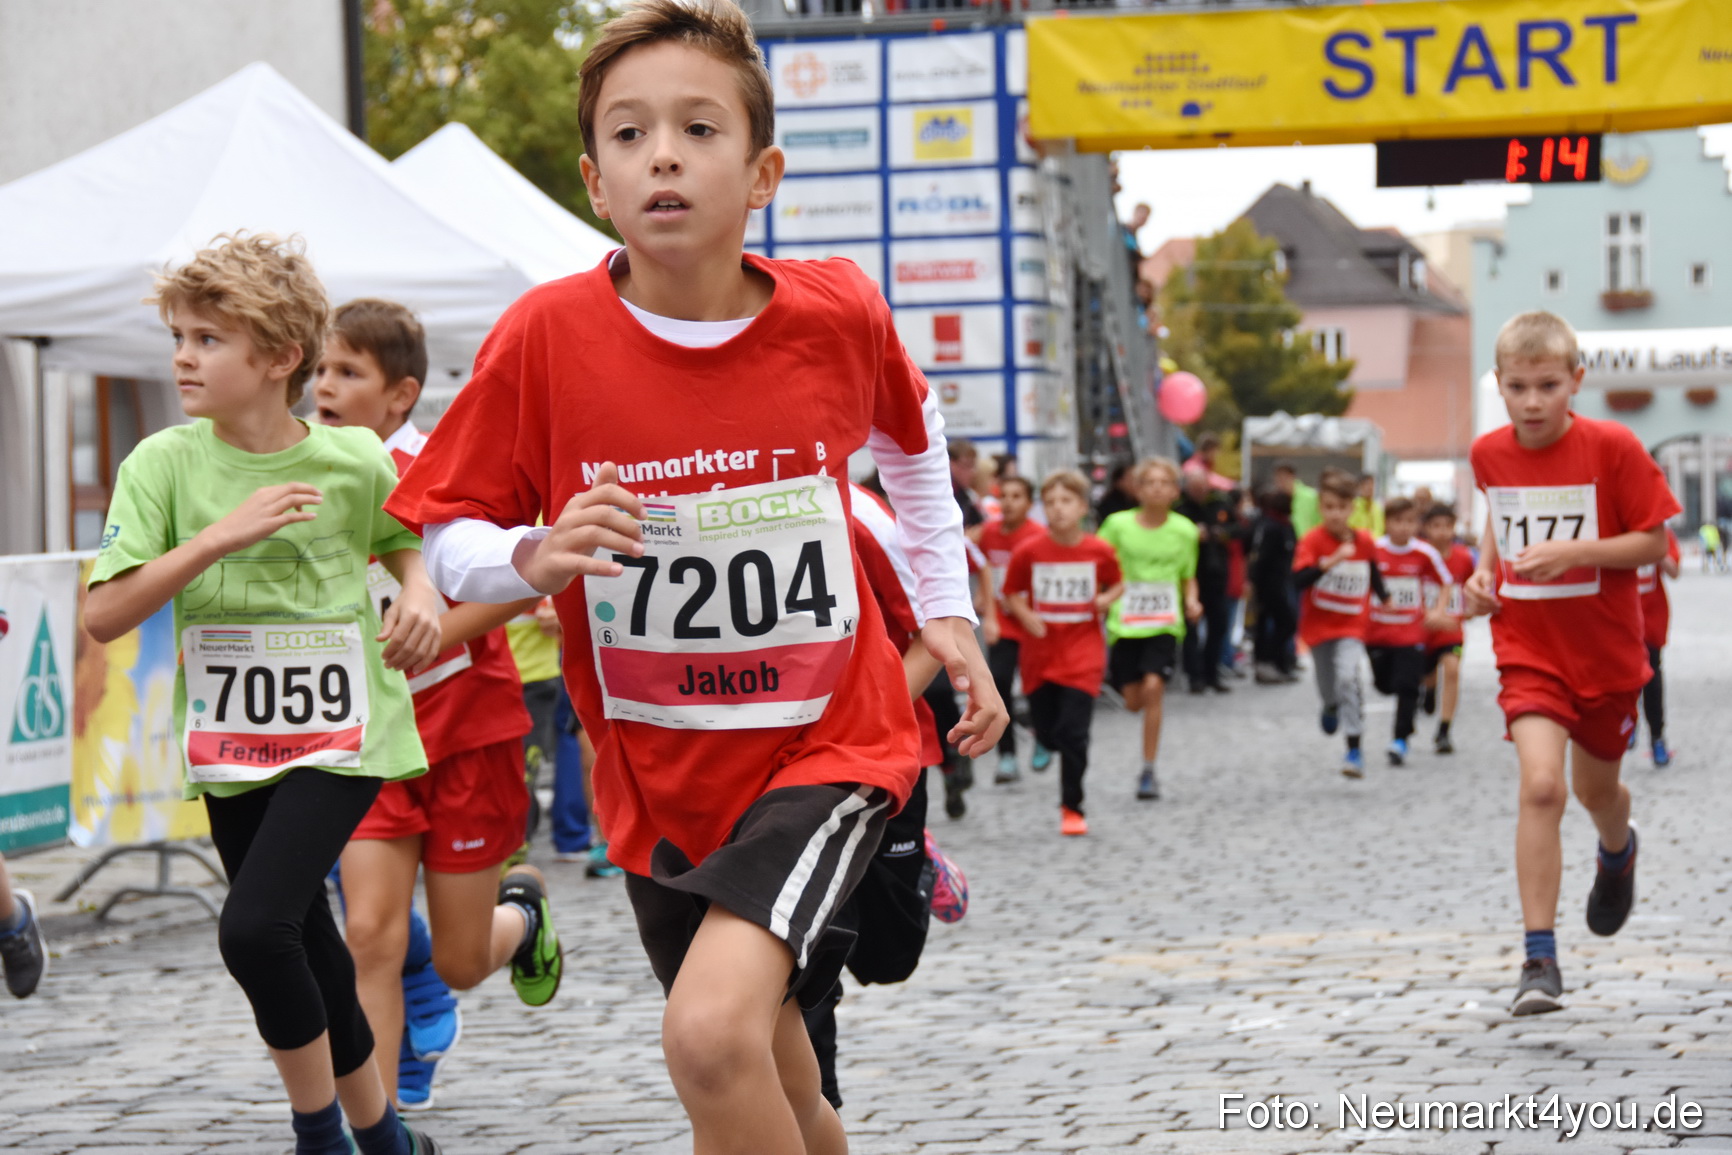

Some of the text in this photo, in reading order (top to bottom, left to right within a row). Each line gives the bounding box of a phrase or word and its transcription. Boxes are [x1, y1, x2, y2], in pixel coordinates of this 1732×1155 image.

[1322, 13, 1639, 102] START
[1505, 135, 1589, 183] 1:14
[581, 449, 759, 485] Numarkter
[697, 486, 823, 531] BOCK
[699, 517, 826, 543] inspired by smart concepts
[1502, 514, 1585, 548] 7177
[612, 540, 837, 639] 7204
[265, 629, 347, 650] BOCK
[603, 630, 613, 644] 6
[843, 619, 853, 634] K
[199, 643, 255, 653] NeuerMarkt
[206, 664, 351, 725] 7059
[677, 661, 780, 696] Jakob
[195, 718, 202, 729] 6
[355, 716, 363, 724] K
